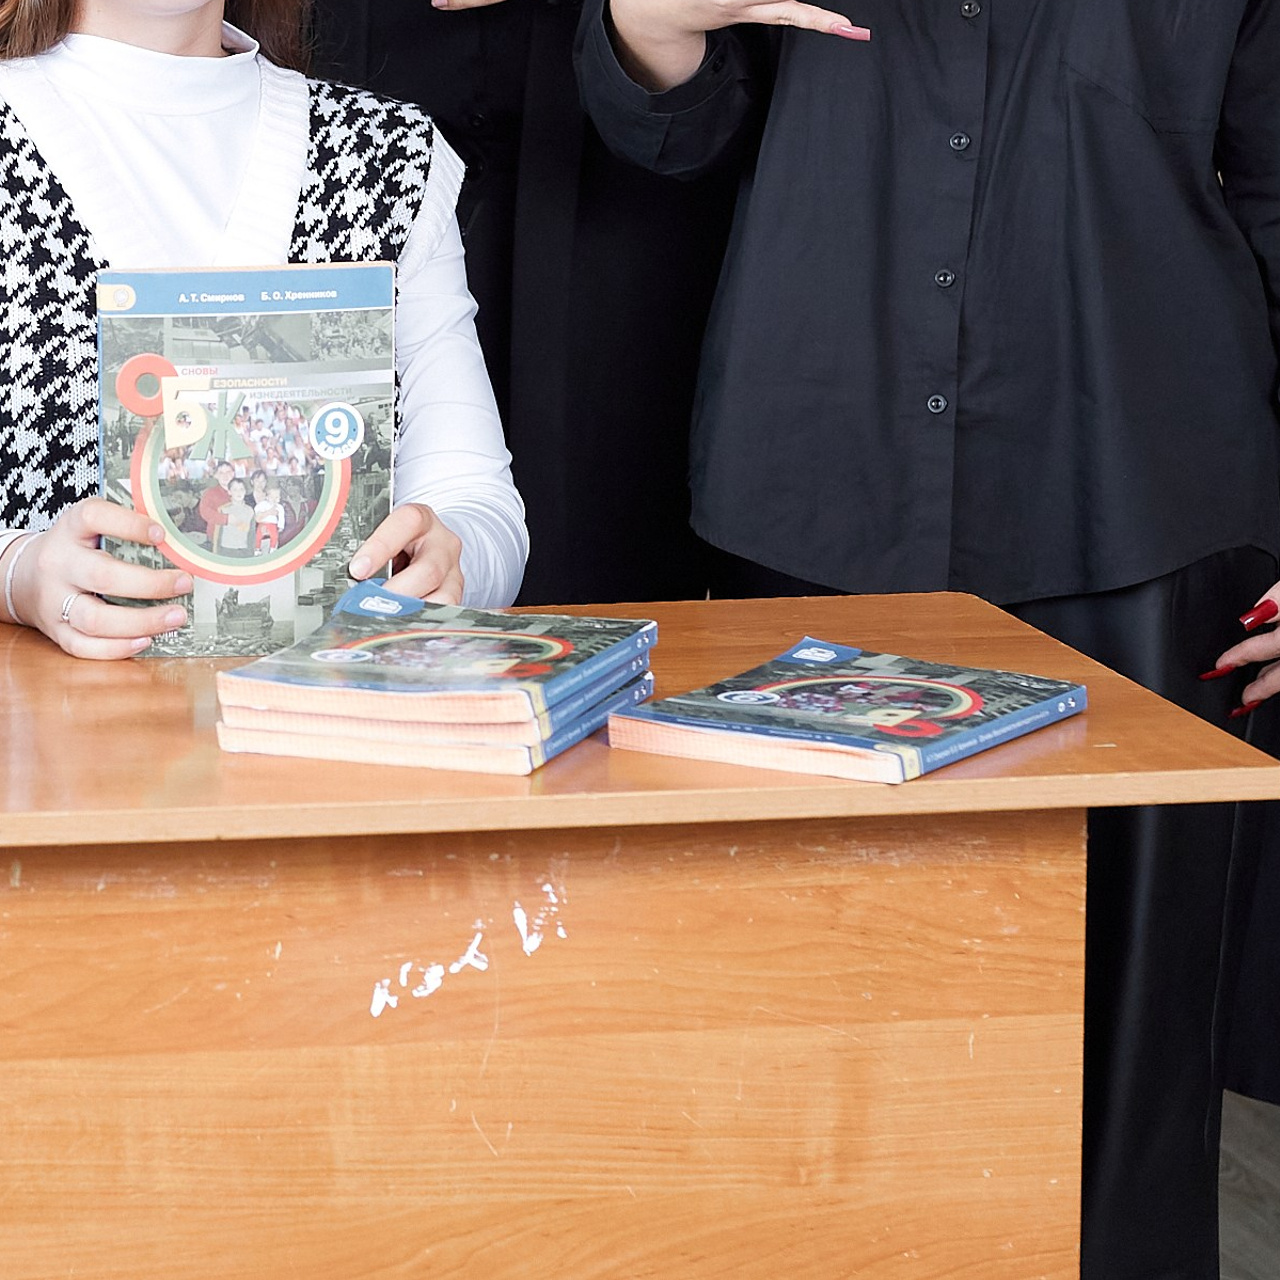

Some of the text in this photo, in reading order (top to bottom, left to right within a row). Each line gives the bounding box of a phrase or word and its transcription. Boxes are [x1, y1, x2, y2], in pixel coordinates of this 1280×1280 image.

[200, 292, 245, 304] Смирнов
[284, 289, 338, 302] Хренников
[181, 367, 219, 376] СНОВЫ
[212, 377, 288, 389] ЕЗОПАСНОСТИ
[249, 387, 353, 400] ИЗНЕДЕЯТЕЛЬНОСТИ
[324, 411, 349, 445] 9
